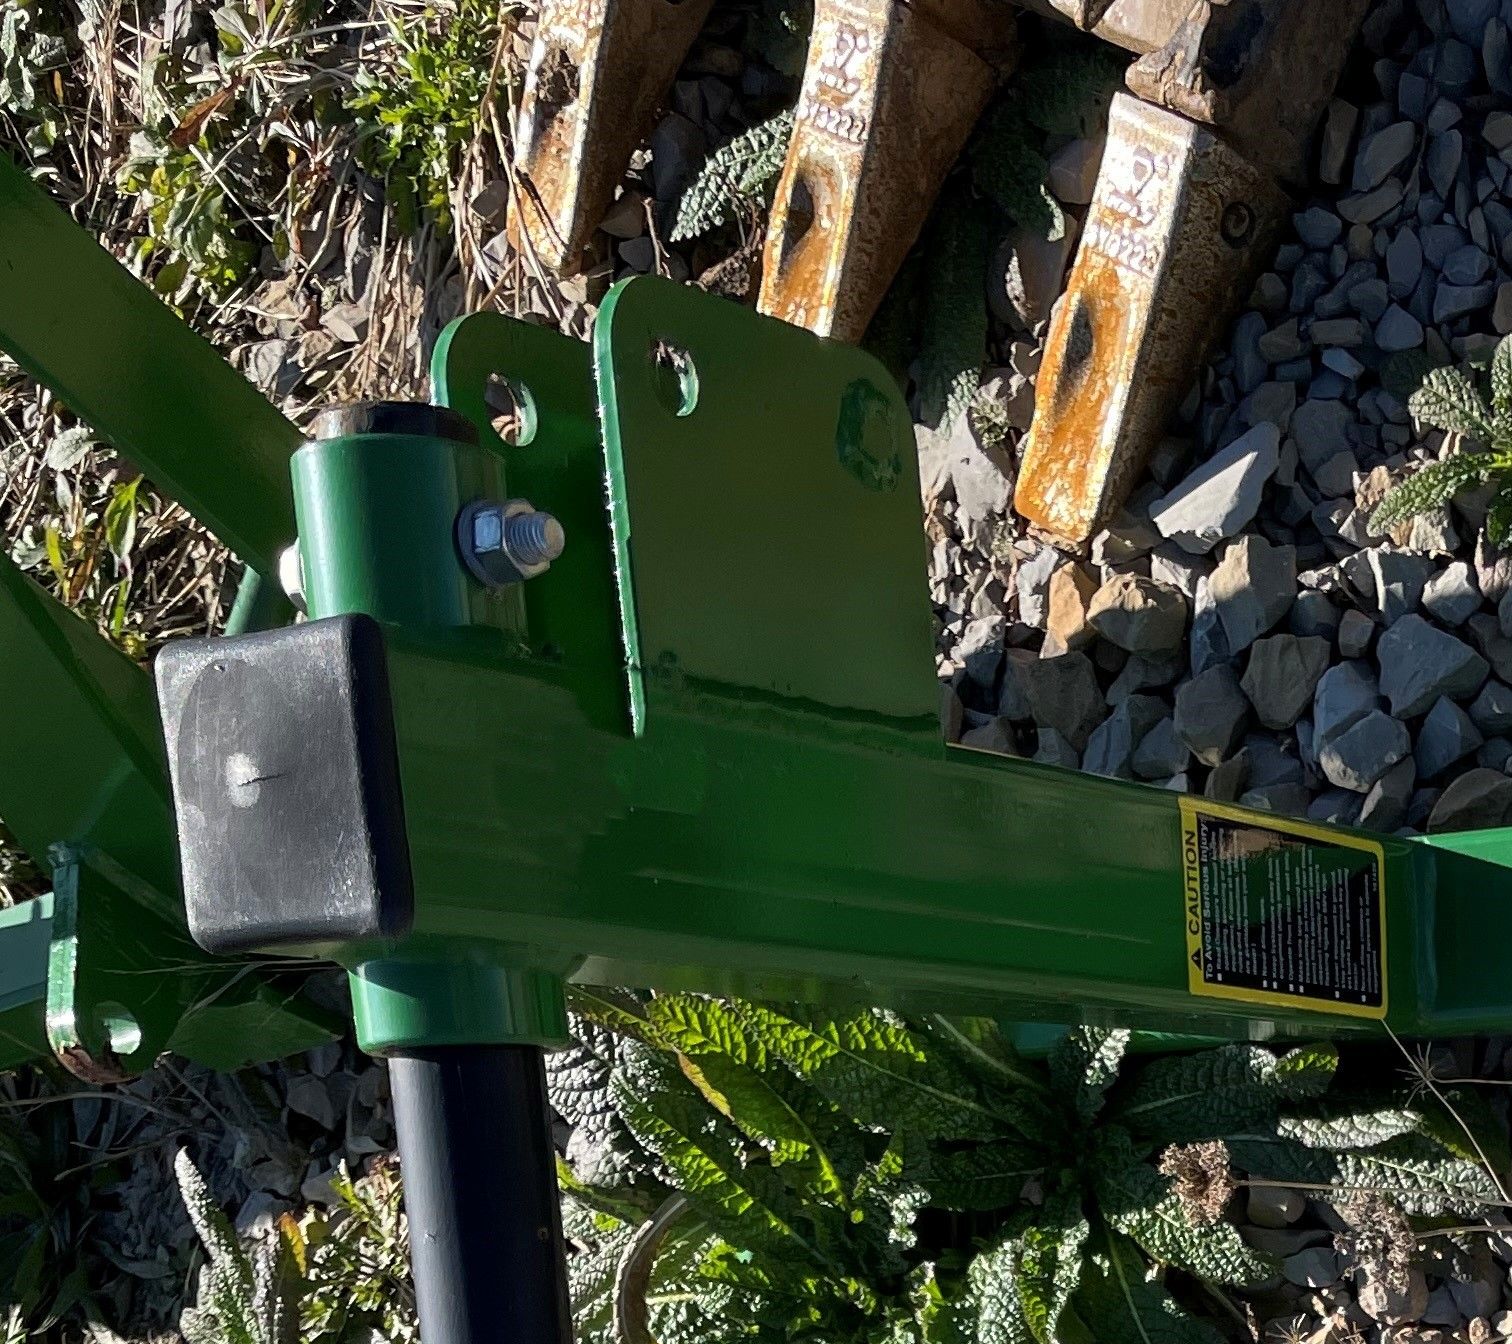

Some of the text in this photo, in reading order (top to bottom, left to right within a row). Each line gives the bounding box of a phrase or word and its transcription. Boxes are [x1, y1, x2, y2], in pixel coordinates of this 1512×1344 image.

[1185, 831, 1200, 935] CAUTION
[1202, 866, 1211, 918] Serious
[1204, 922, 1212, 962] Avoid
[1205, 964, 1213, 980] To
